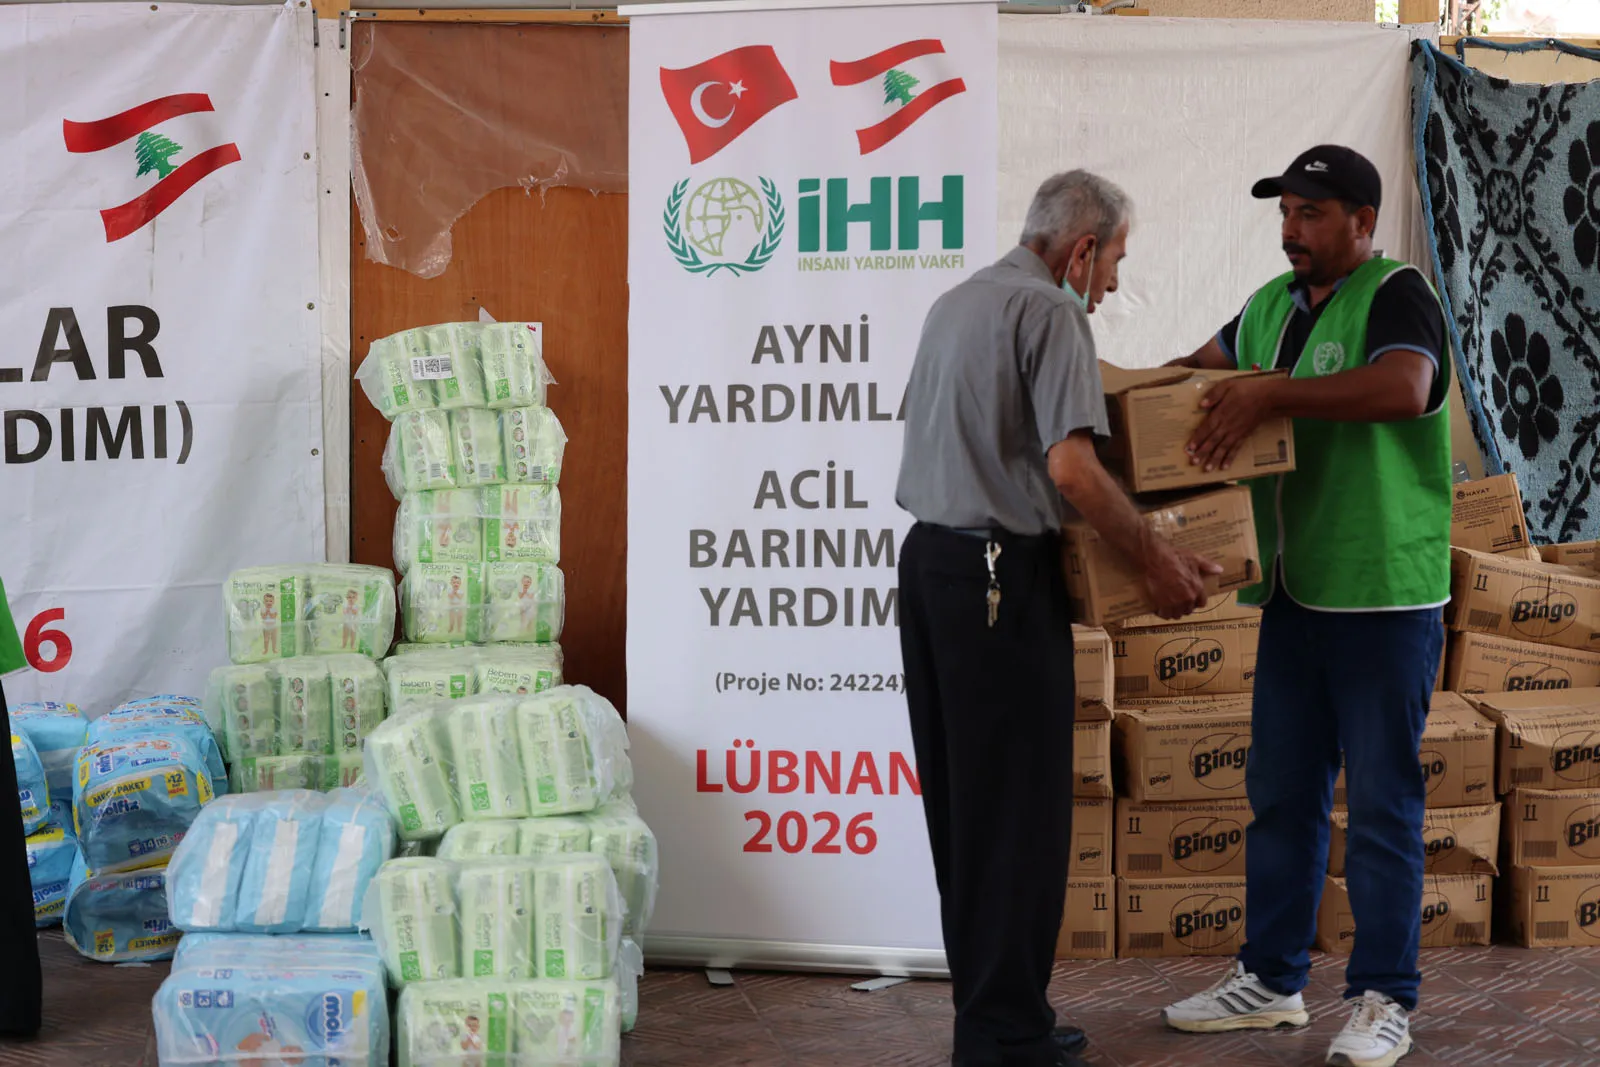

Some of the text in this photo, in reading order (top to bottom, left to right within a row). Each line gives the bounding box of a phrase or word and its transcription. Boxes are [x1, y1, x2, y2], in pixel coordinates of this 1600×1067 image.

[854, 256, 915, 271] YARDIM
[919, 254, 964, 270] VAKFI
[751, 314, 869, 364] AYNİ
[659, 382, 909, 424] YARDIML
[753, 460, 869, 509] ACİL
[1466, 487, 1490, 497] HAYAT
[689, 528, 896, 568] BARINM
[699, 587, 900, 627] YARDIM
[1511, 599, 1575, 623] Bingo
[1159, 648, 1222, 681] Bingo
[715, 672, 906, 696] (Proje No: 24224)
[696, 739, 922, 795] LÜBNAN
[118, 780, 146, 793] PAKET
[743, 810, 878, 855] 2026
[1174, 829, 1241, 860] Bingo
[1175, 906, 1242, 938] Bingo
